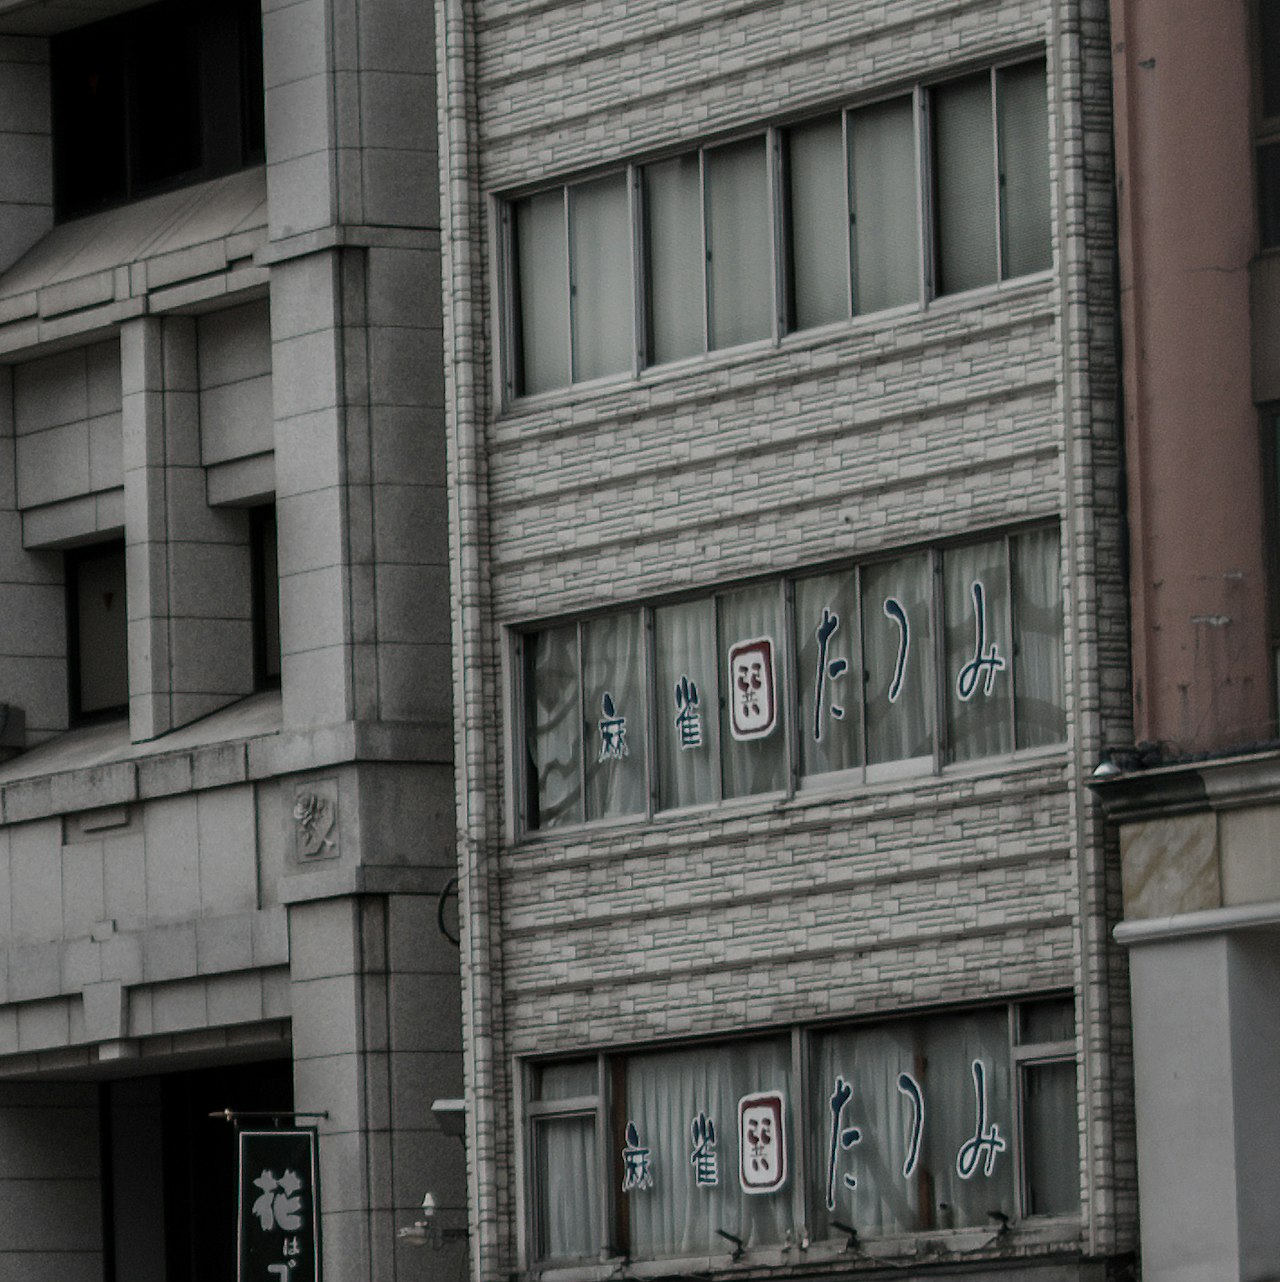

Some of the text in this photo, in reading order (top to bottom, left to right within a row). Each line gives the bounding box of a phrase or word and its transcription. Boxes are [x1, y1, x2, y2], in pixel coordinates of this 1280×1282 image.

[597, 675, 702, 762] 麻雀
[813, 581, 1005, 742] たつみ
[621, 1111, 718, 1192] 麻雀
[825, 1059, 1005, 1212] たつみ
